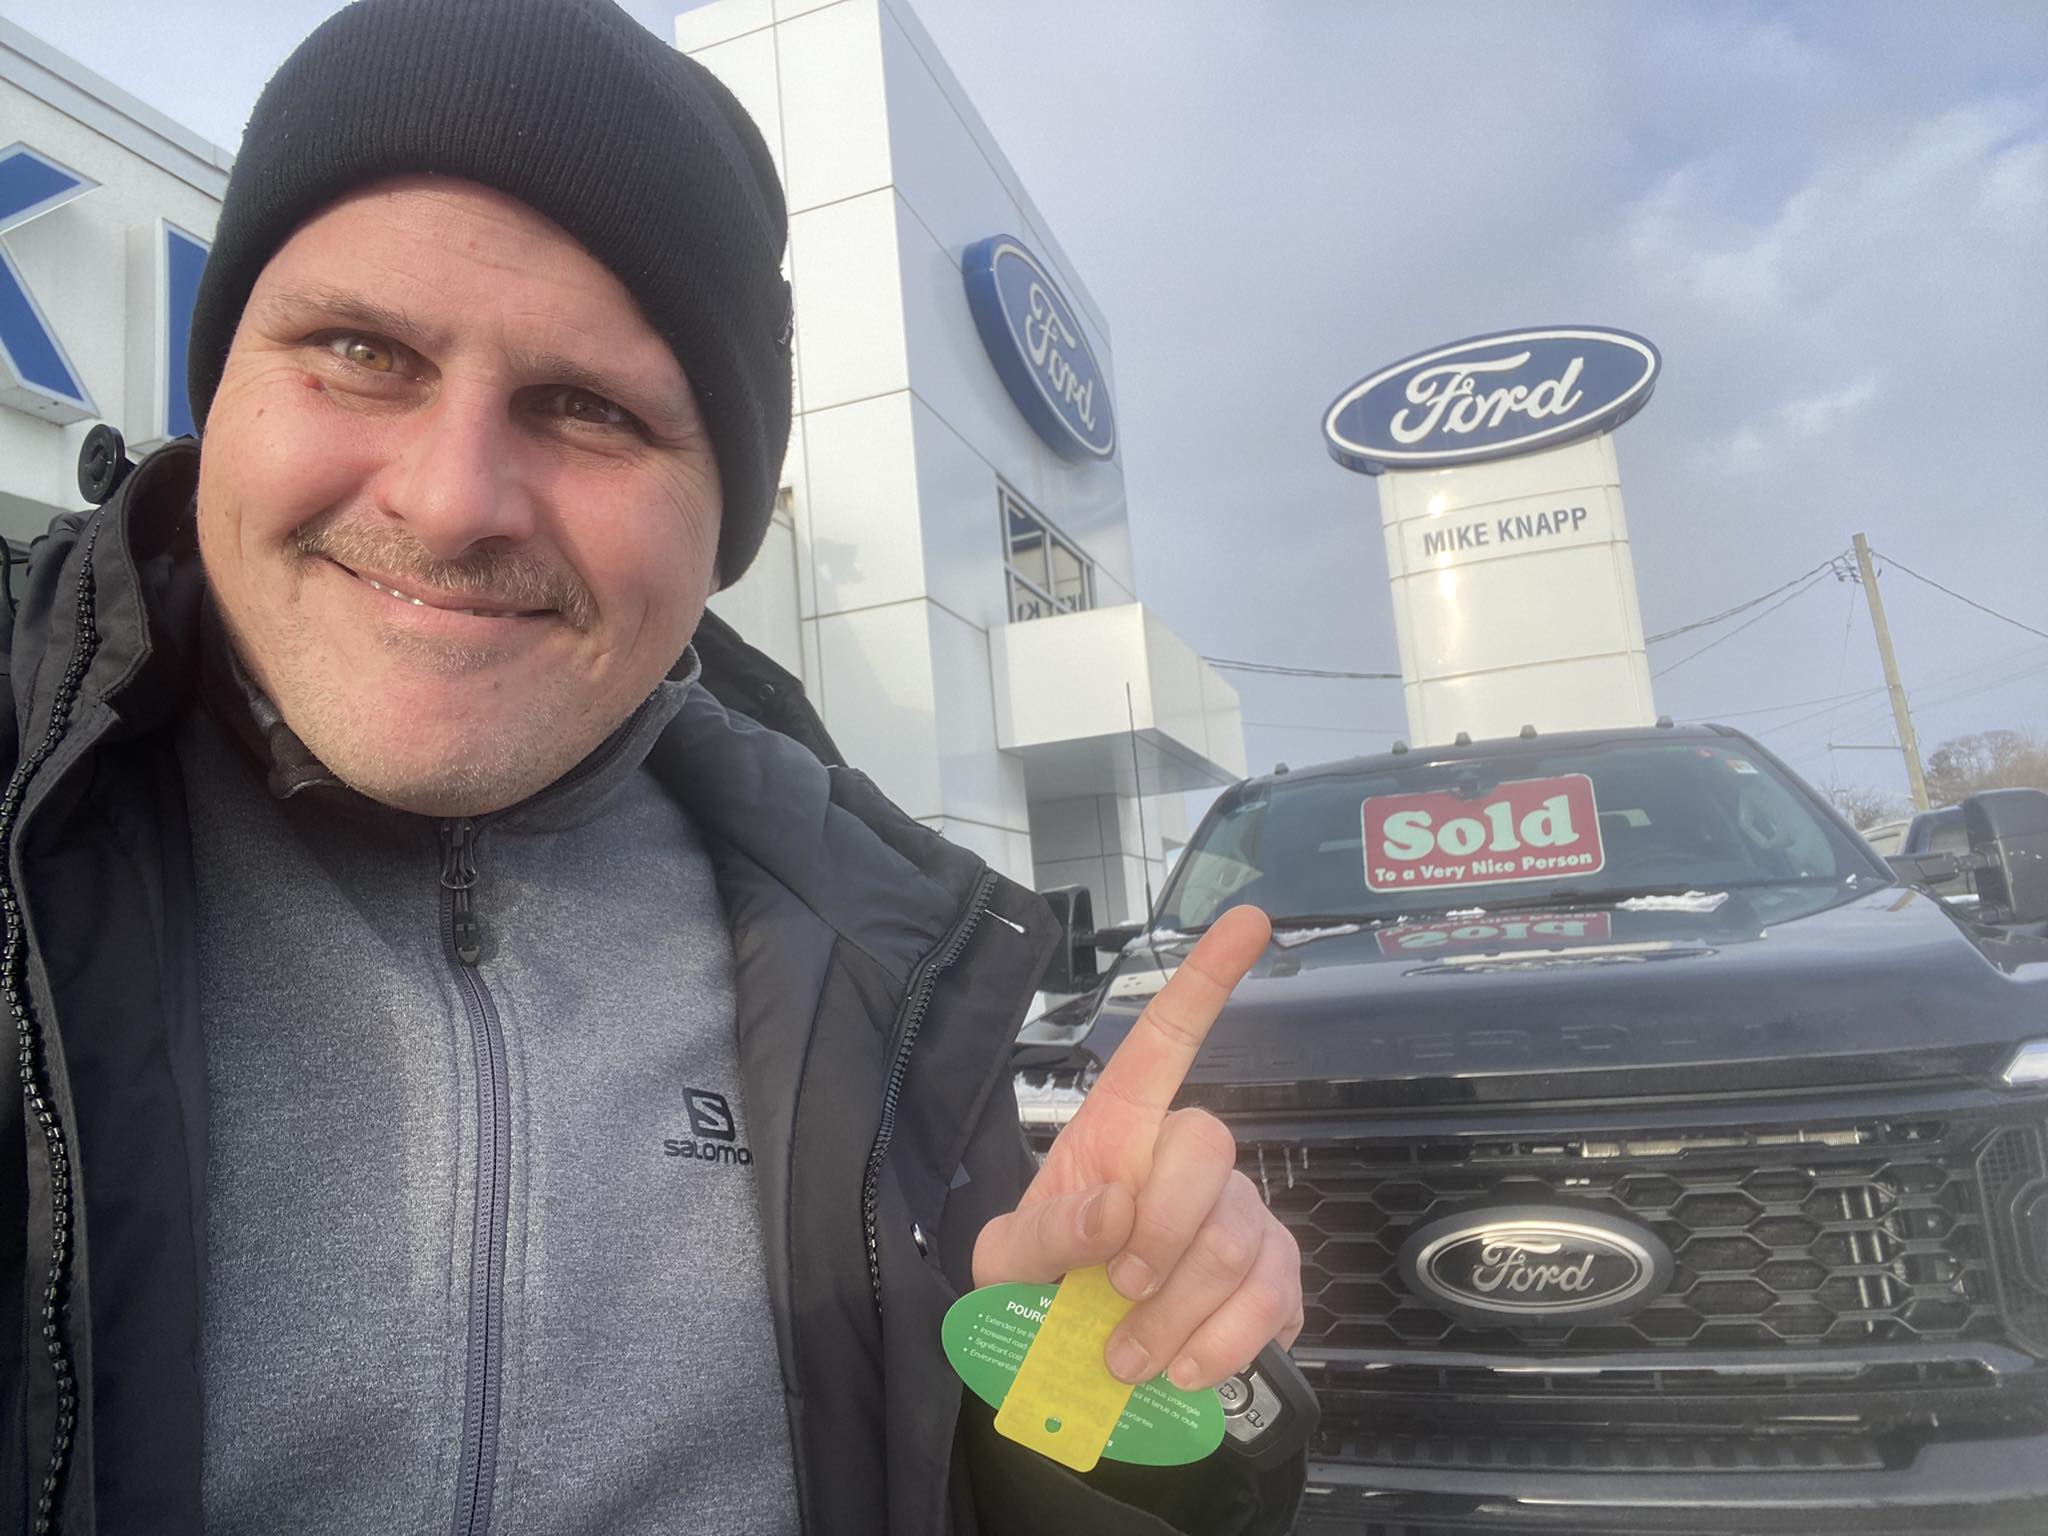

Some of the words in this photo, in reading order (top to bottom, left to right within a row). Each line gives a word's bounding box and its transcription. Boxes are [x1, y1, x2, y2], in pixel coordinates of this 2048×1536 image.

[1026, 282, 1095, 431] Ford
[1390, 351, 1584, 444] Ford
[1423, 522, 1490, 557] MIKE
[1498, 507, 1588, 543] KNAPP
[1382, 795, 1580, 861] Sold
[1375, 868, 1397, 882] To
[1402, 868, 1415, 880] a
[1420, 864, 1465, 880] Very
[1472, 859, 1515, 875] Nice
[1522, 852, 1593, 870] Person
[1472, 1242, 1595, 1292] Ford
[1122, 1409, 1154, 1429] portantes
